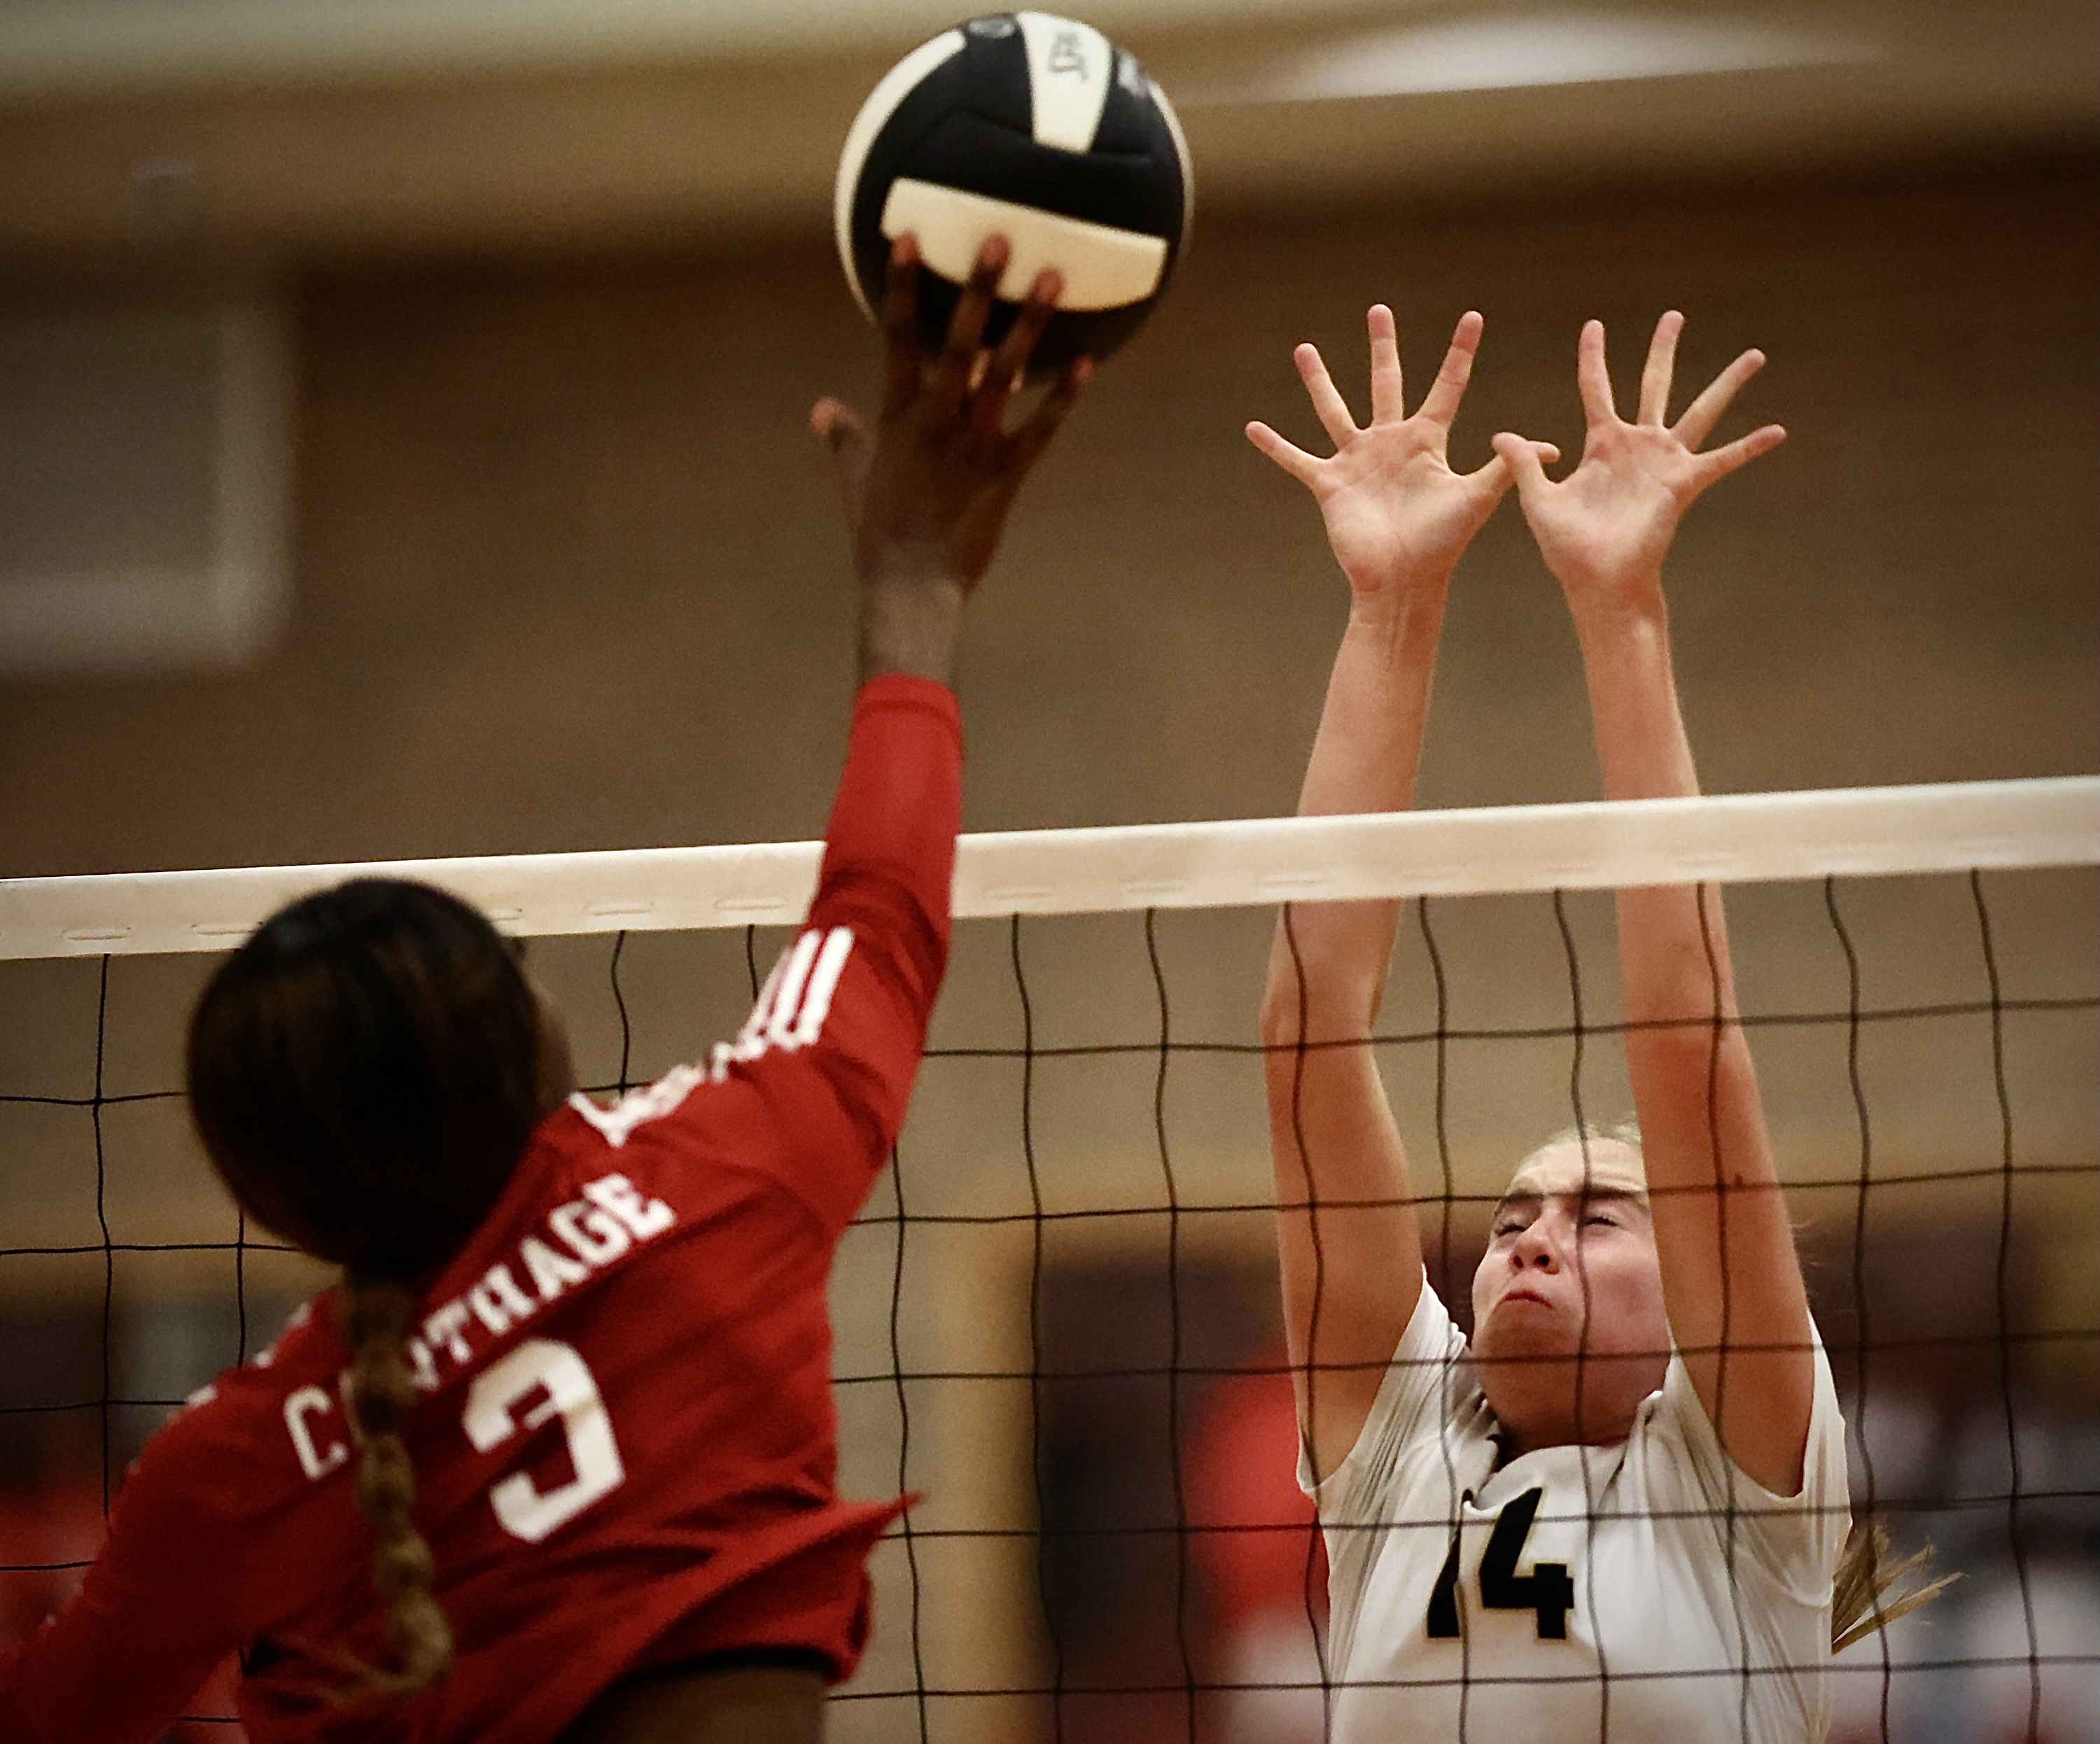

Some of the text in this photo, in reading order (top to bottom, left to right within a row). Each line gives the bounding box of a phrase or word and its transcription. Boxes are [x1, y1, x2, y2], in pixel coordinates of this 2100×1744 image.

[283, 1172, 677, 1482] CTHAGE
[461, 1337, 626, 1543] 3
[1427, 1486, 1575, 1640] 14
